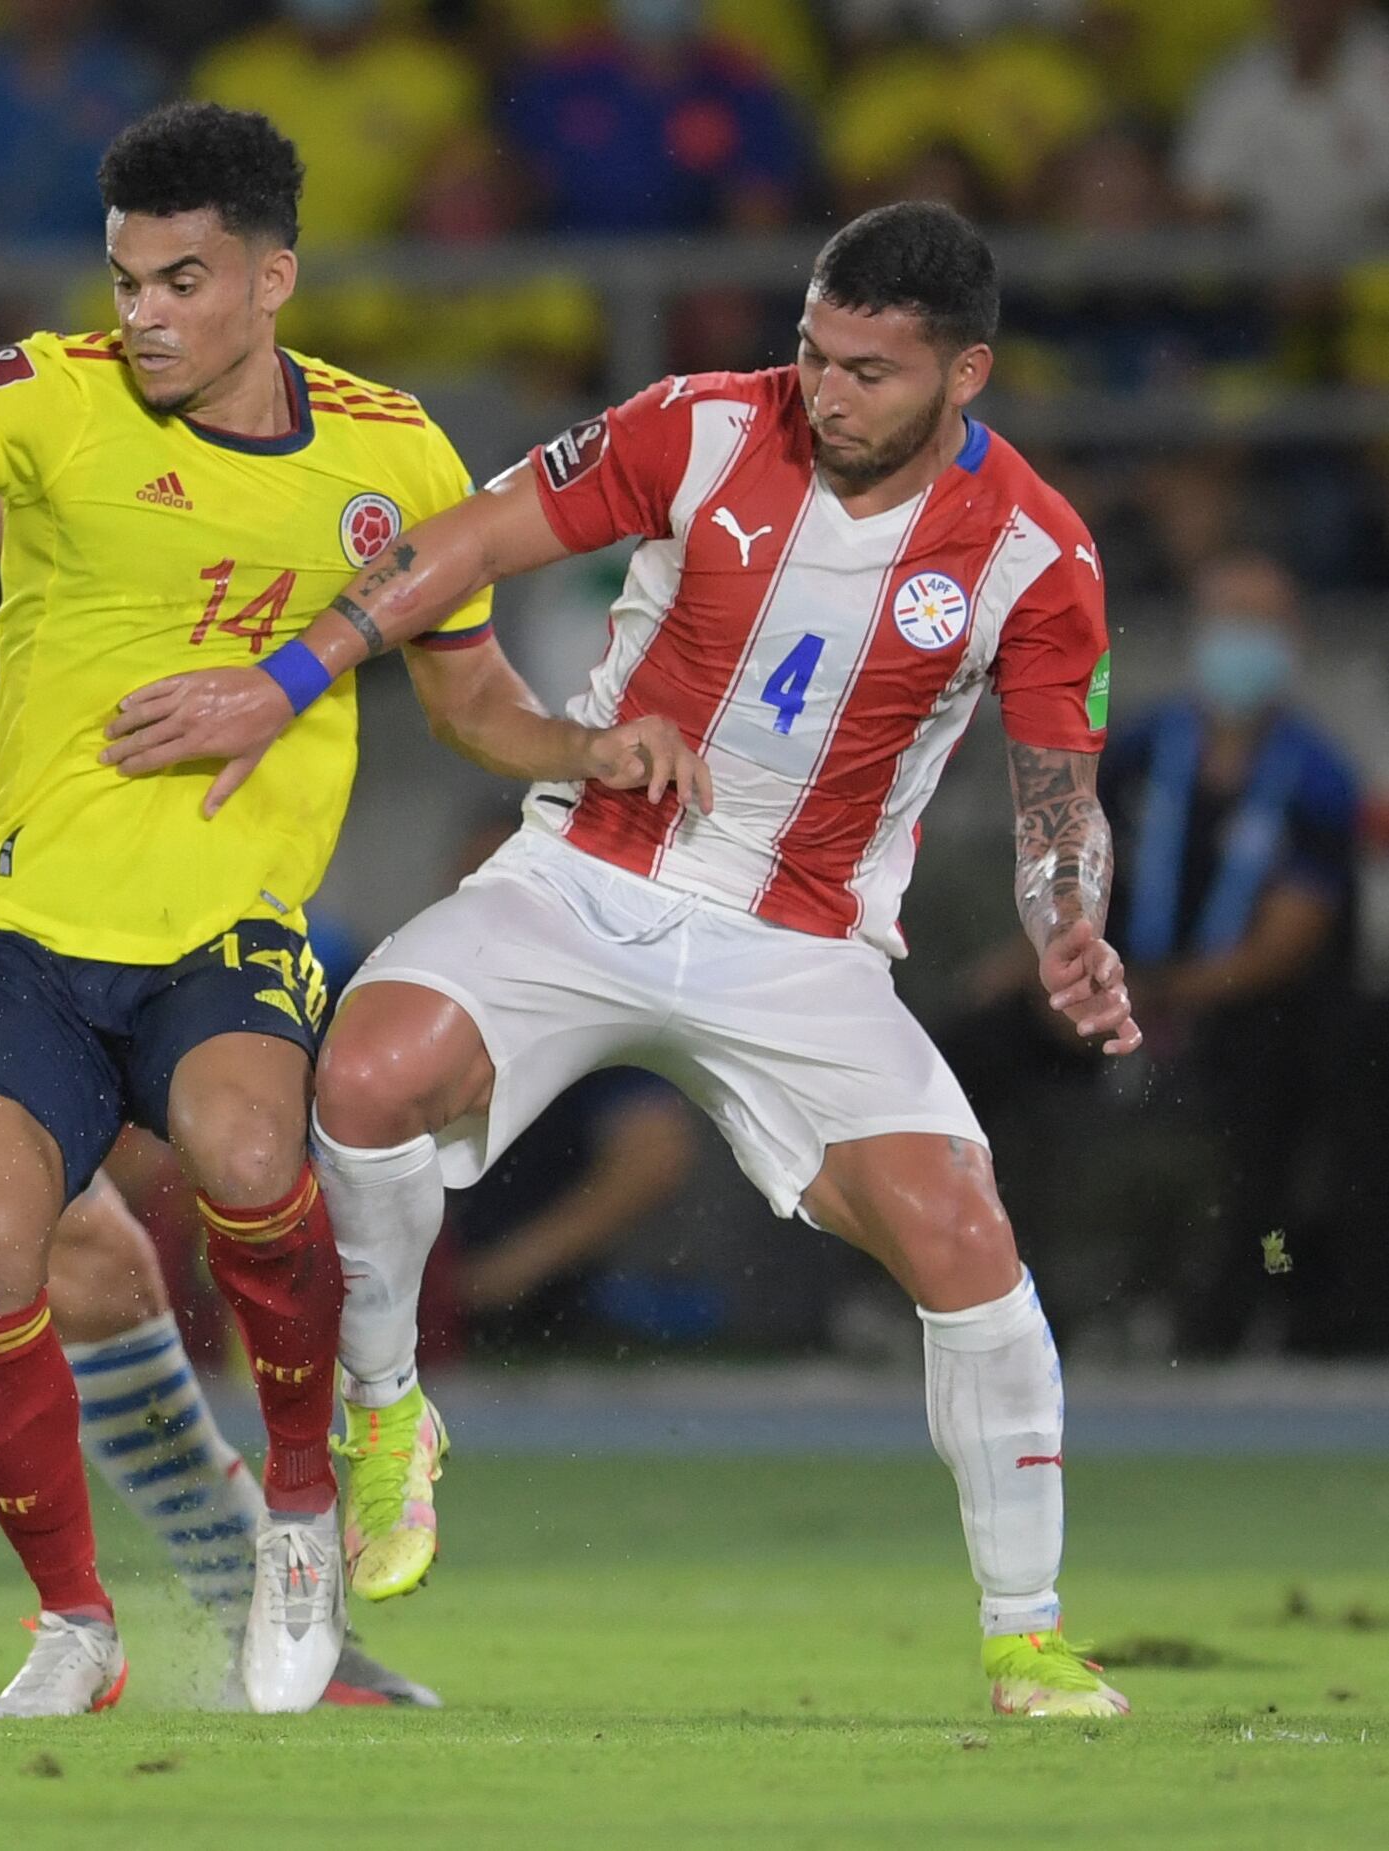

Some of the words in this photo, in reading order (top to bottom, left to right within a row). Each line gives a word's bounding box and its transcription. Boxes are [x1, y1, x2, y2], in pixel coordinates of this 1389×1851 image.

[136, 489, 194, 511] adidas
[188, 556, 297, 655] 14
[927, 577, 953, 594] APF
[760, 632, 826, 736] 4
